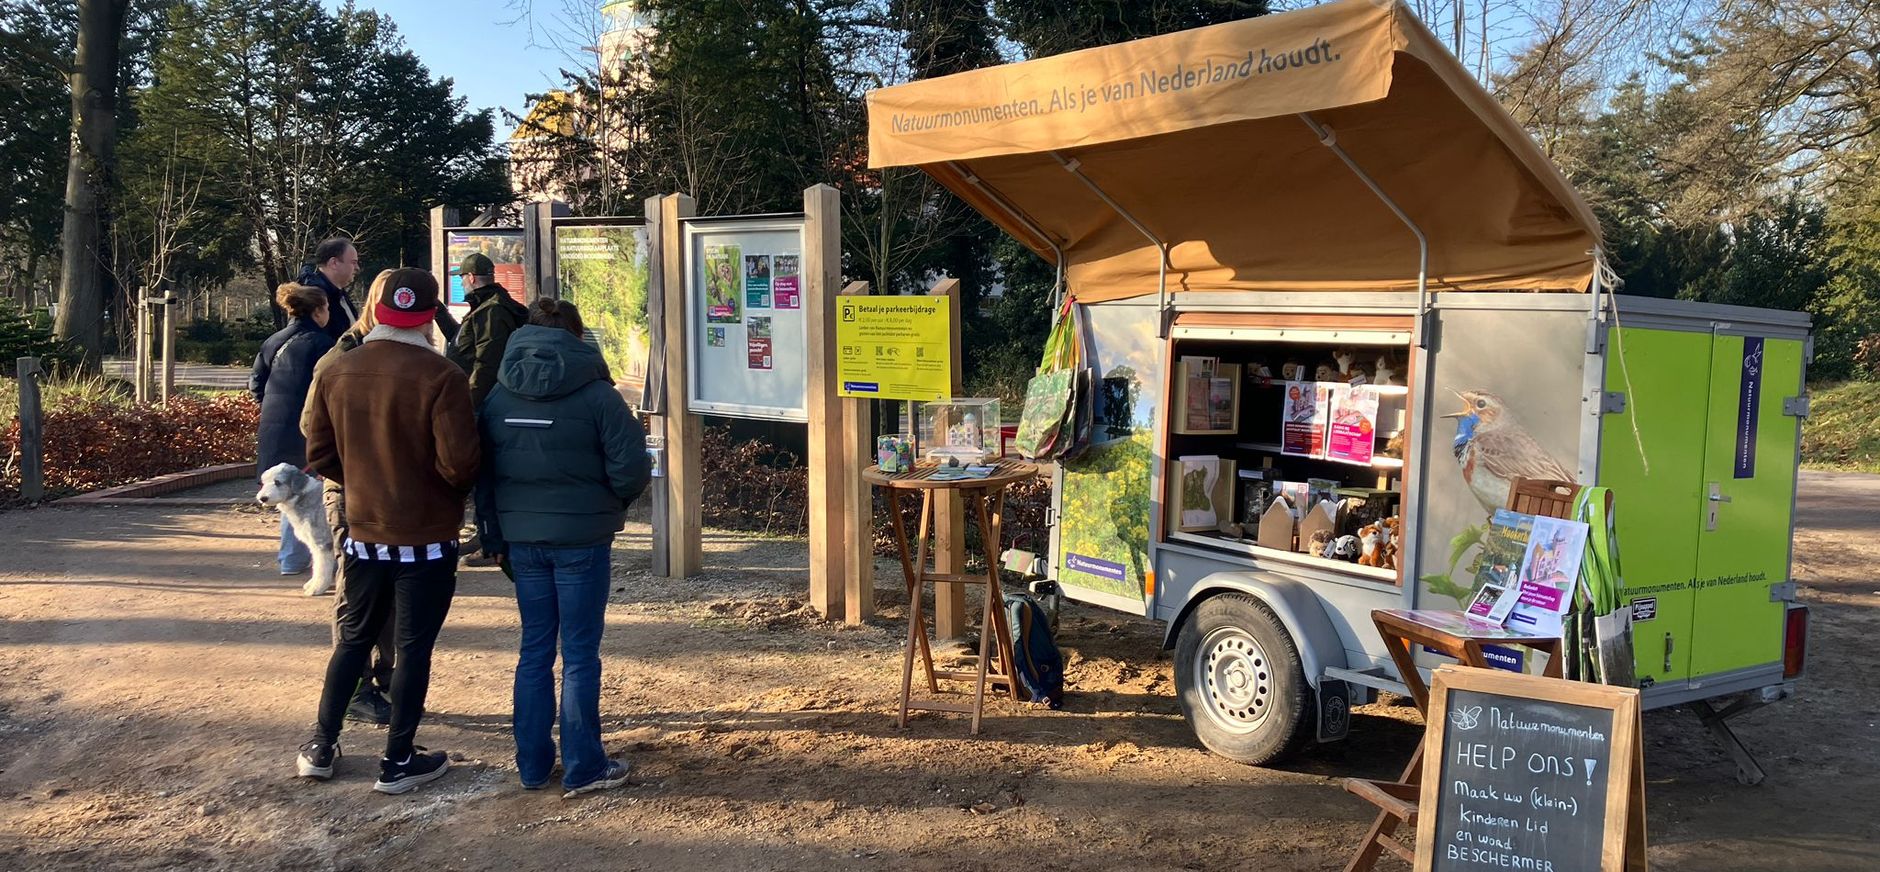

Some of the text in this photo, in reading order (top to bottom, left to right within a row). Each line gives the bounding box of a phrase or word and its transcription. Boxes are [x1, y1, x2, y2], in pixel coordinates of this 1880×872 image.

[889, 36, 1342, 134] Natuurmonumenten. Als je van Nederland houdt.
[859, 305, 936, 315] Betaal je parkeerbijdrage
[1743, 381, 1754, 469] Natuurmonumenten
[1623, 582, 1687, 596] atuurmonumenten.
[1706, 579, 1717, 587] van
[1718, 572, 1748, 586] Nederland
[1749, 570, 1766, 582] houdt.
[1490, 706, 1605, 742] Natuurmonumenten
[1457, 741, 1517, 770] HELP
[1503, 791, 1523, 804] uw
[1455, 830, 1472, 842] en
